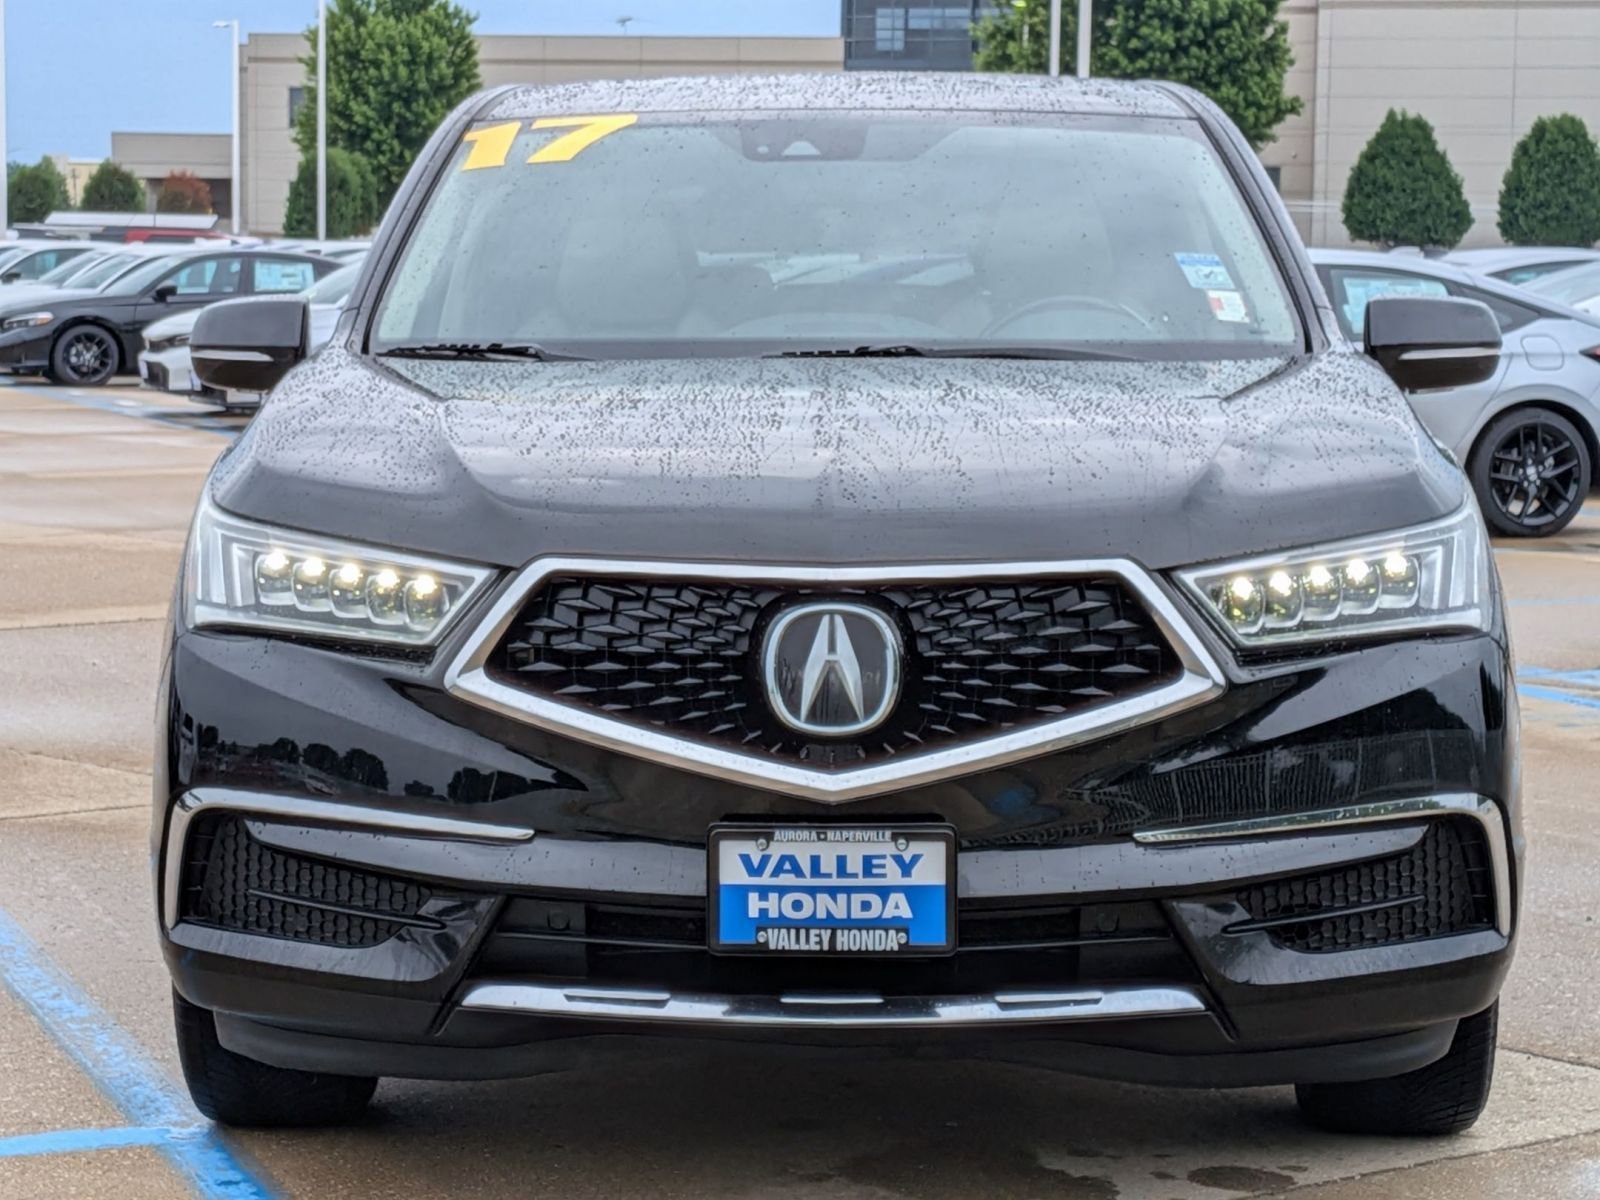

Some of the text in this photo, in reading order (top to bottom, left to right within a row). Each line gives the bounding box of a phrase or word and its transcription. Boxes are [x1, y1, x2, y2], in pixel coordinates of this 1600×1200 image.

[461, 113, 639, 171] 17
[773, 830, 892, 842] AURORA NAPERVILLE
[738, 853, 924, 879] VALLEY
[748, 892, 913, 919] HONDA
[766, 928, 900, 951] VALLEY HONDA
